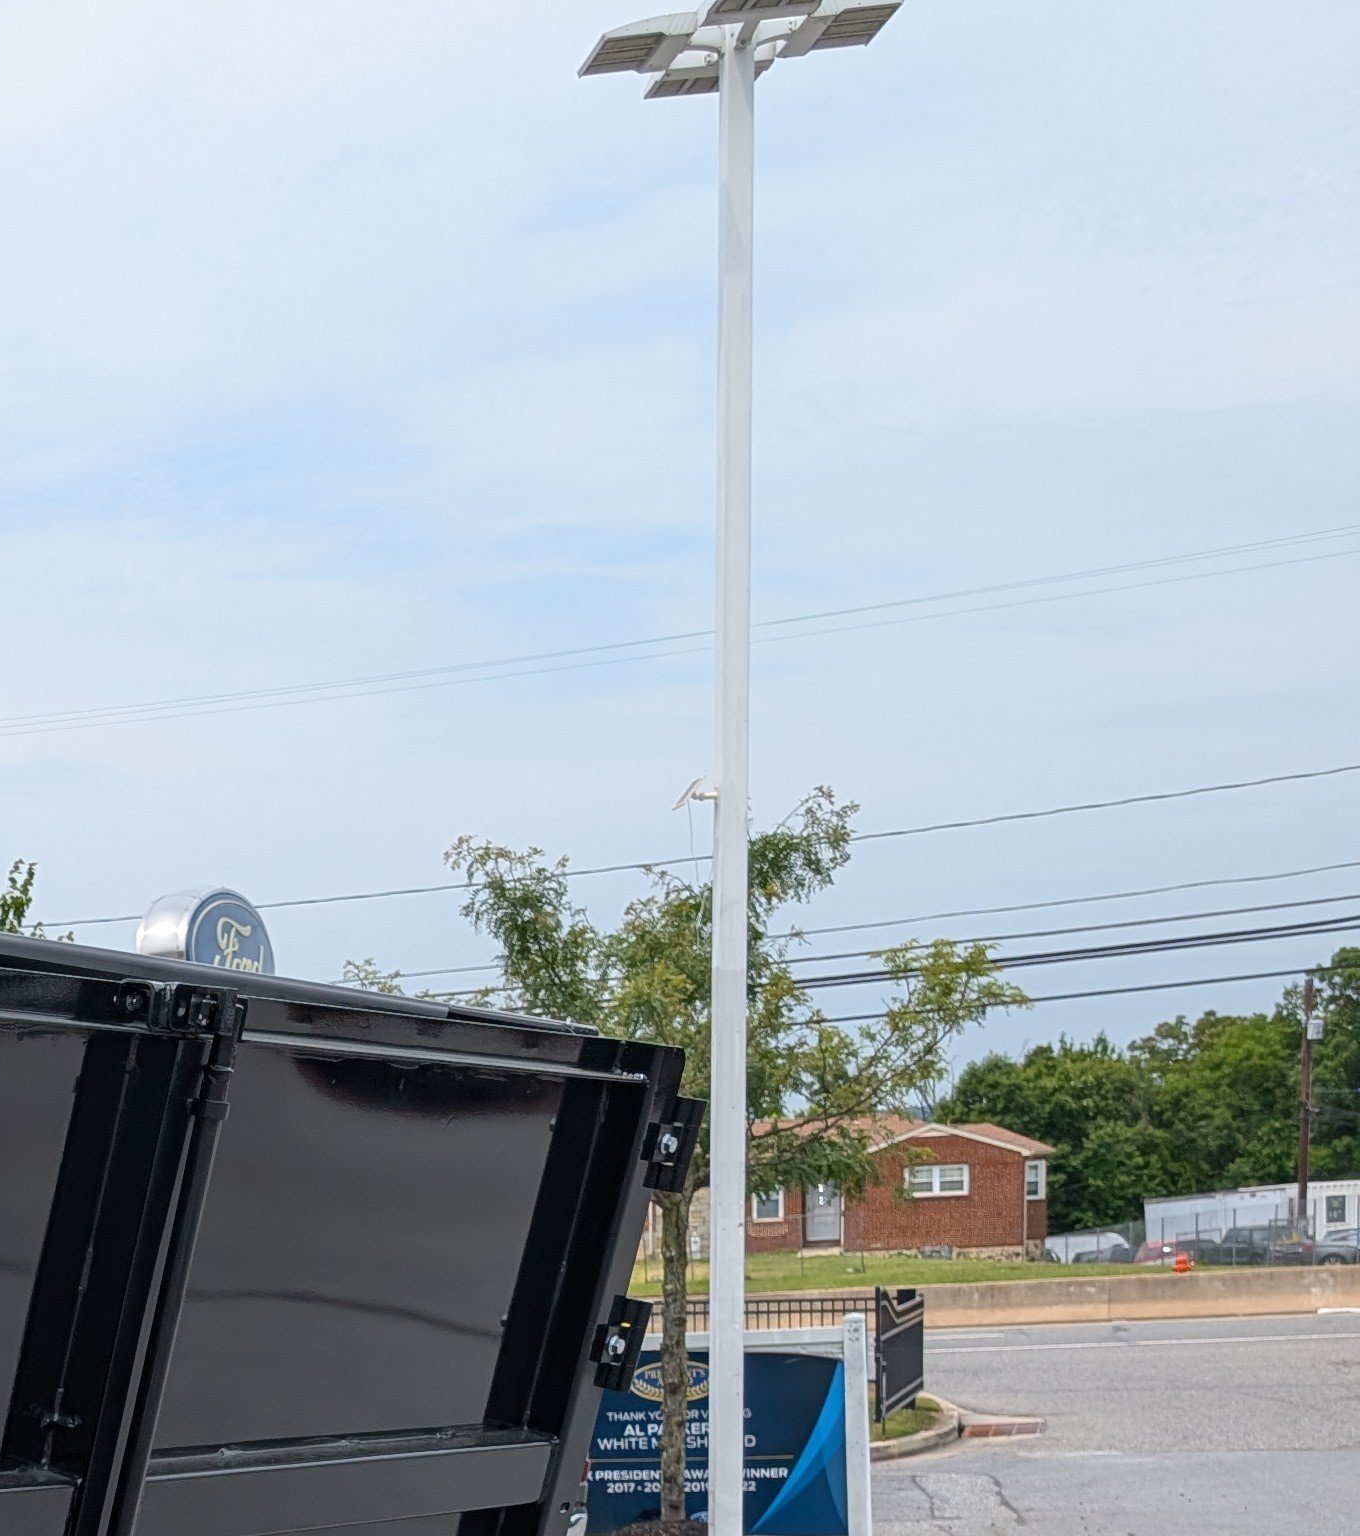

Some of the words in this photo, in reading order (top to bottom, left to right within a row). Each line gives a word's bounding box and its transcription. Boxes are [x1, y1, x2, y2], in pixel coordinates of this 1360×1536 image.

[214, 916, 265, 973] Ford
[606, 1411, 647, 1422] THANK
[623, 1424, 646, 1437] AL
[597, 1436, 648, 1451] WHITE
[651, 1435, 709, 1450] MSH
[684, 1467, 710, 1480] AWA
[606, 1482, 635, 1494] 2017
